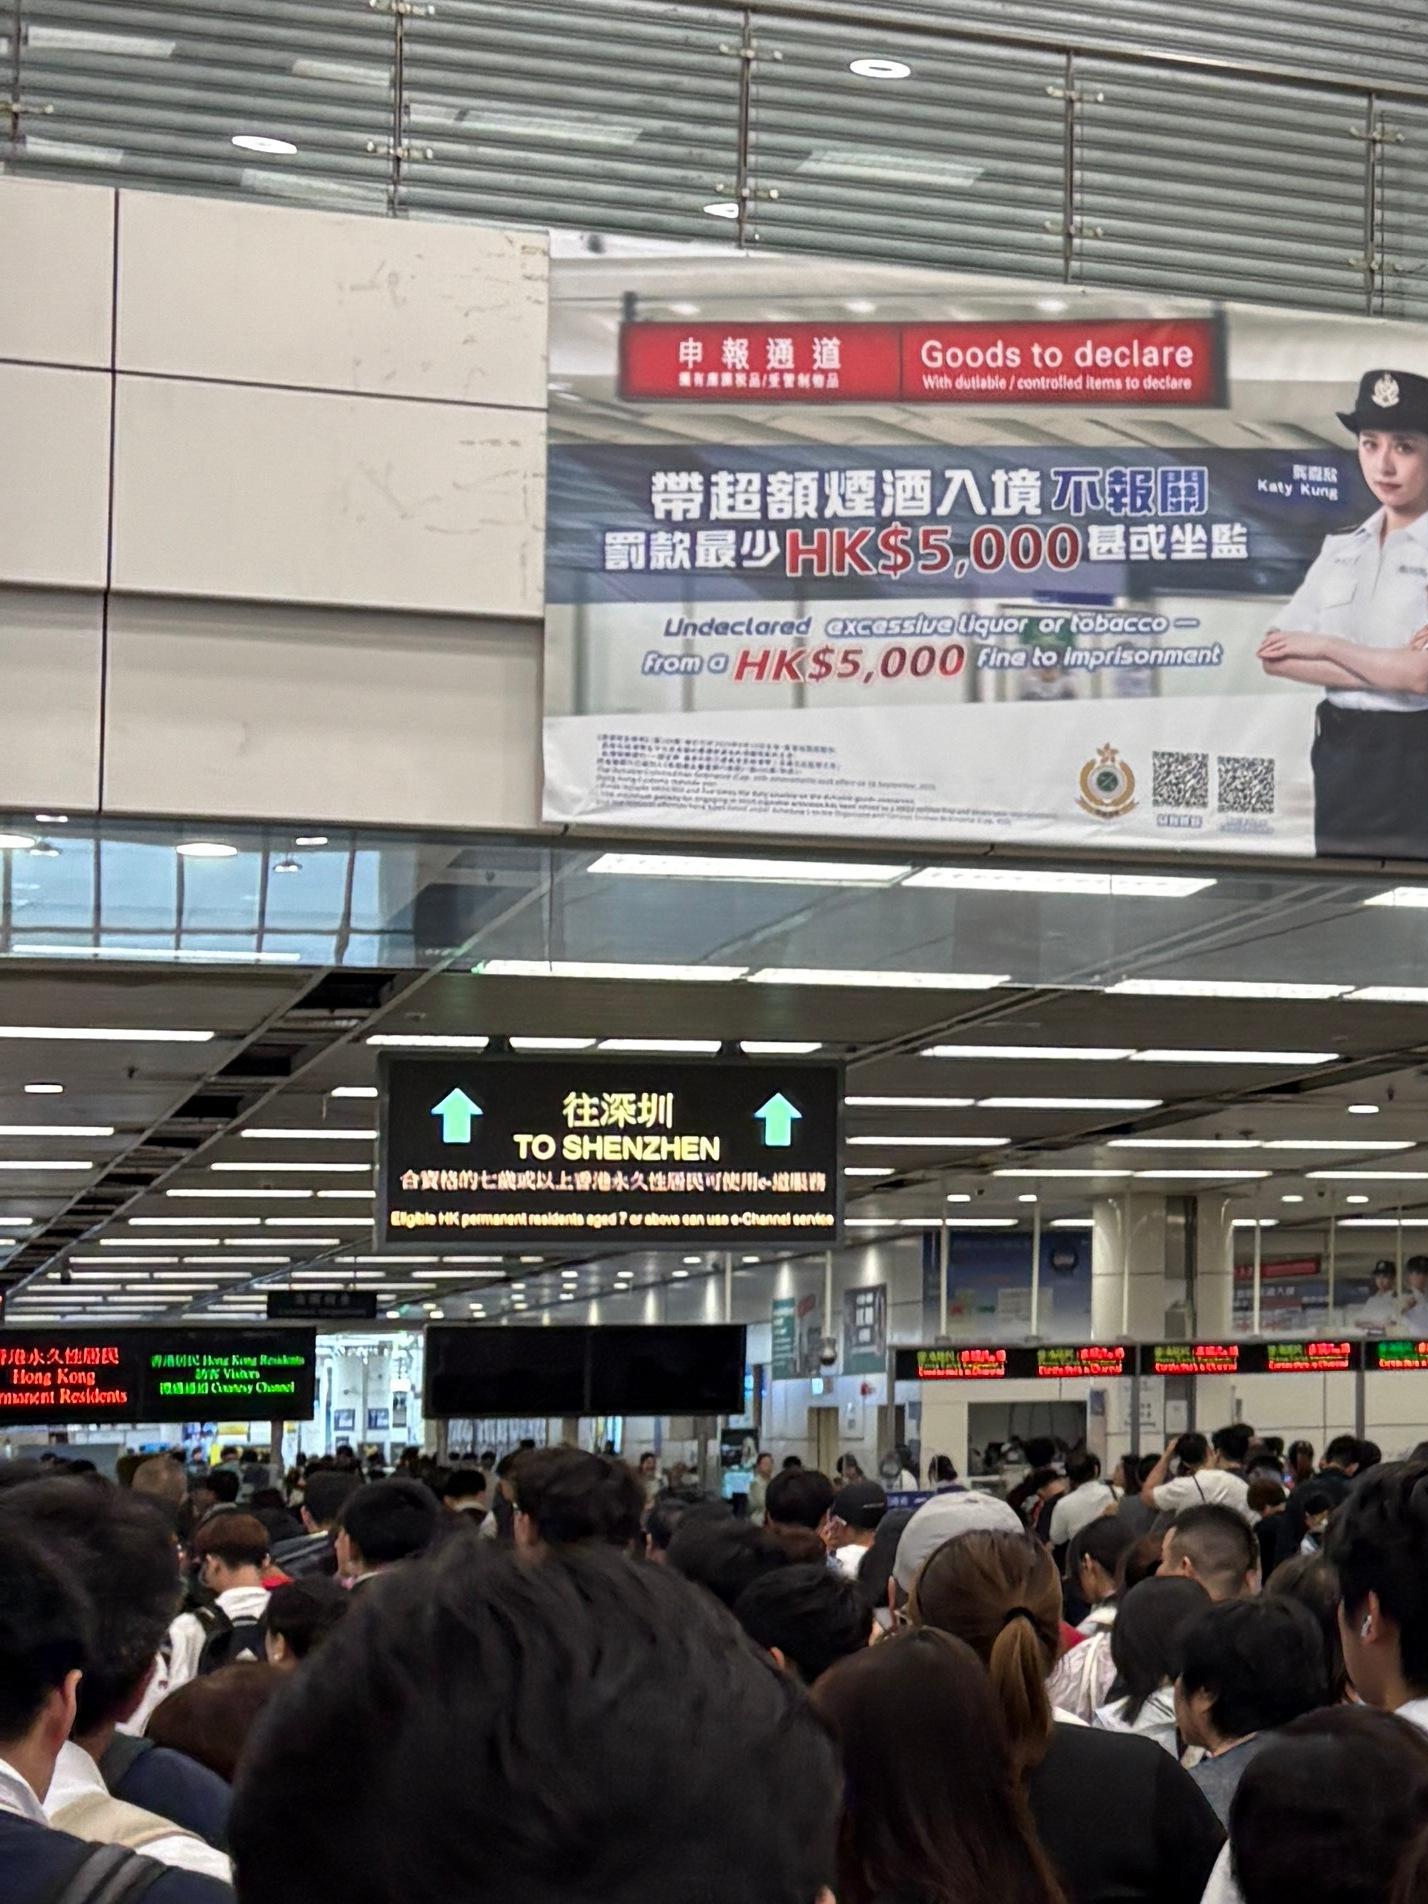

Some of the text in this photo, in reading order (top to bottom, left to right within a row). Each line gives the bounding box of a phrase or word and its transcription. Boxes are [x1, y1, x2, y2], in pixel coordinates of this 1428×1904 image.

[678, 336, 841, 370] 申報通道
[920, 339, 1193, 368] Goods to declare
[922, 374, 951, 390] With
[955, 374, 1005, 391] dutiable
[1017, 374, 1082, 390] controlled
[1086, 374, 1122, 390] items
[1126, 376, 1140, 390] to
[1143, 374, 1192, 390] declare
[1257, 478, 1293, 497] Katy
[664, 616, 812, 637] Undeclared
[825, 612, 955, 637] excessive
[958, 612, 1029, 638] liquor
[1037, 617, 1065, 632] or
[1069, 613, 1171, 636] tobacco
[707, 652, 729, 674] a
[731, 643, 966, 683] HK$5,000
[1031, 645, 1058, 667] to
[1062, 642, 1223, 672] imprisonment
[562, 1091, 674, 1129] 往深圳
[513, 1134, 720, 1161] TO SHENZHEN
[390, 1210, 437, 1228] Eligible
[438, 1211, 460, 1226] HK
[461, 1212, 527, 1228] permanent
[529, 1212, 584, 1227] residents
[793, 1213, 835, 1226] service
[13, 1368, 96, 1386] Hong Kong
[0, 1387, 128, 1405] manent Residents
